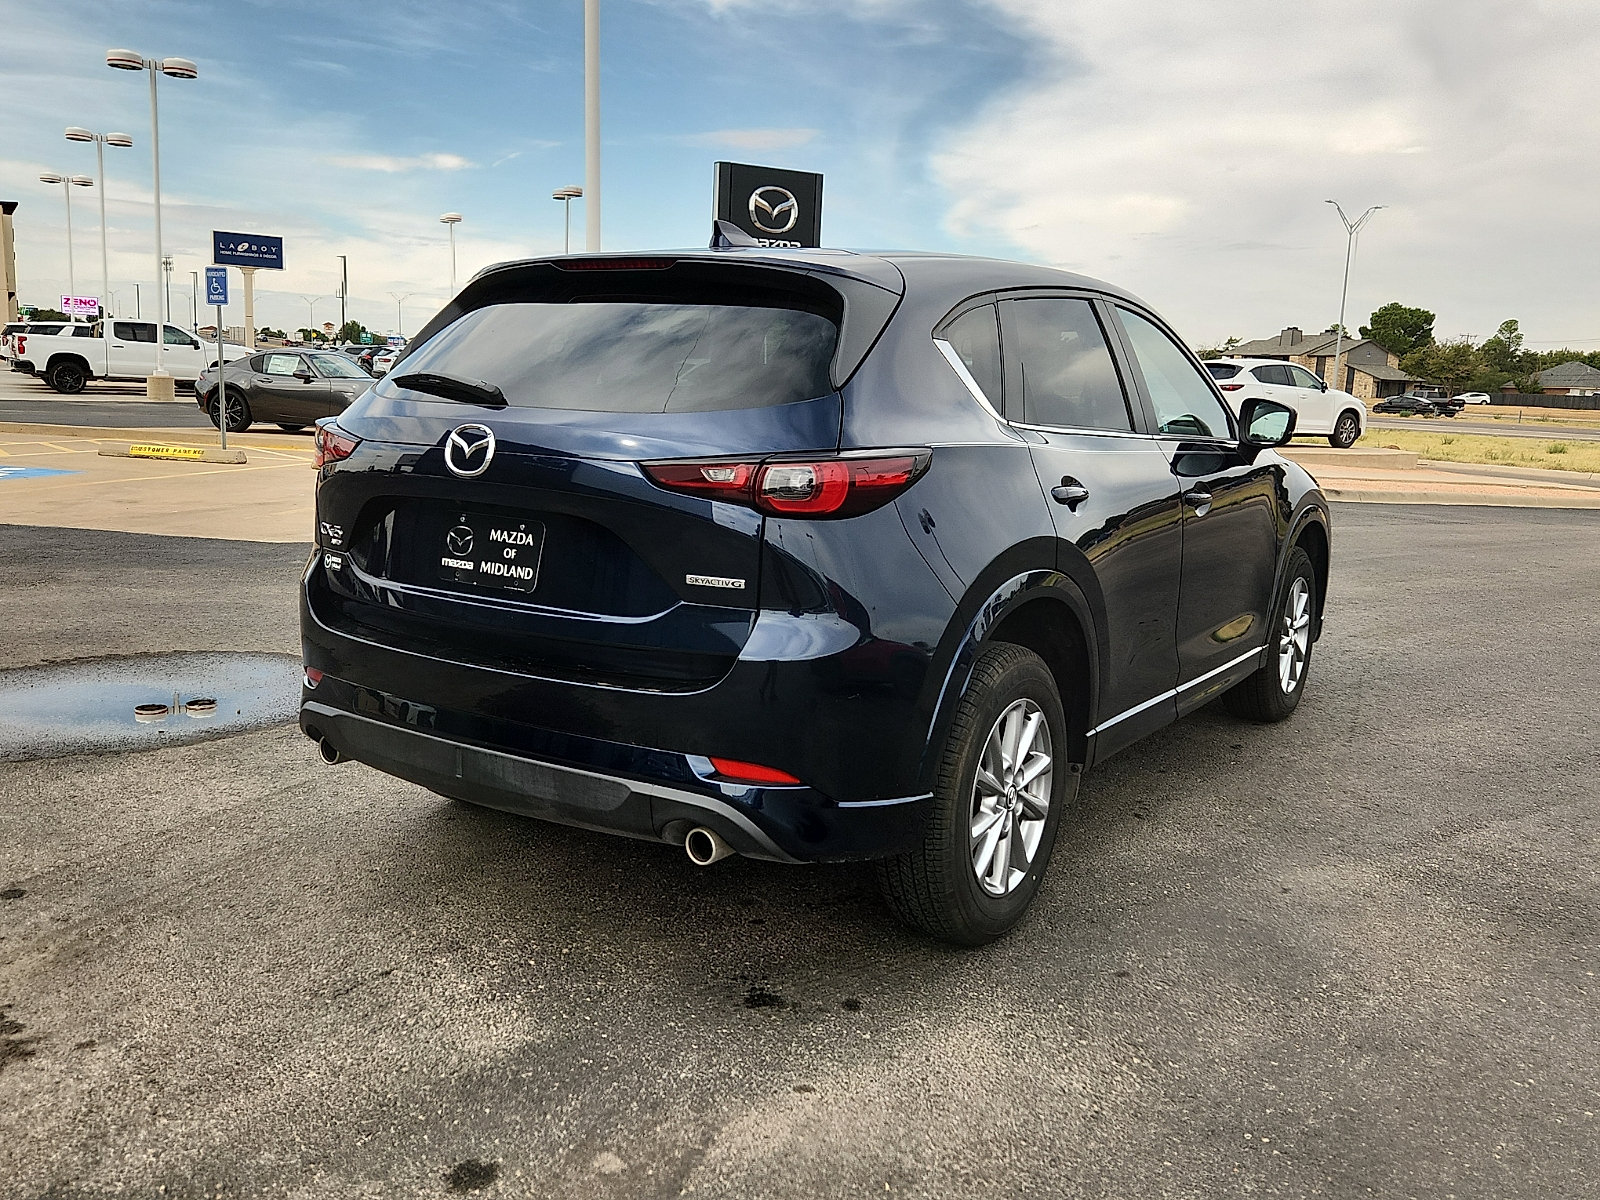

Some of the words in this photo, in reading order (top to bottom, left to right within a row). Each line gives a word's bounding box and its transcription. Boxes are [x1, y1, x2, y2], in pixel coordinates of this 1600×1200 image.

[489, 528, 534, 547] MAZDA
[503, 547, 518, 560] OF
[441, 557, 475, 571] mazda
[479, 560, 534, 580] MIDLAND
